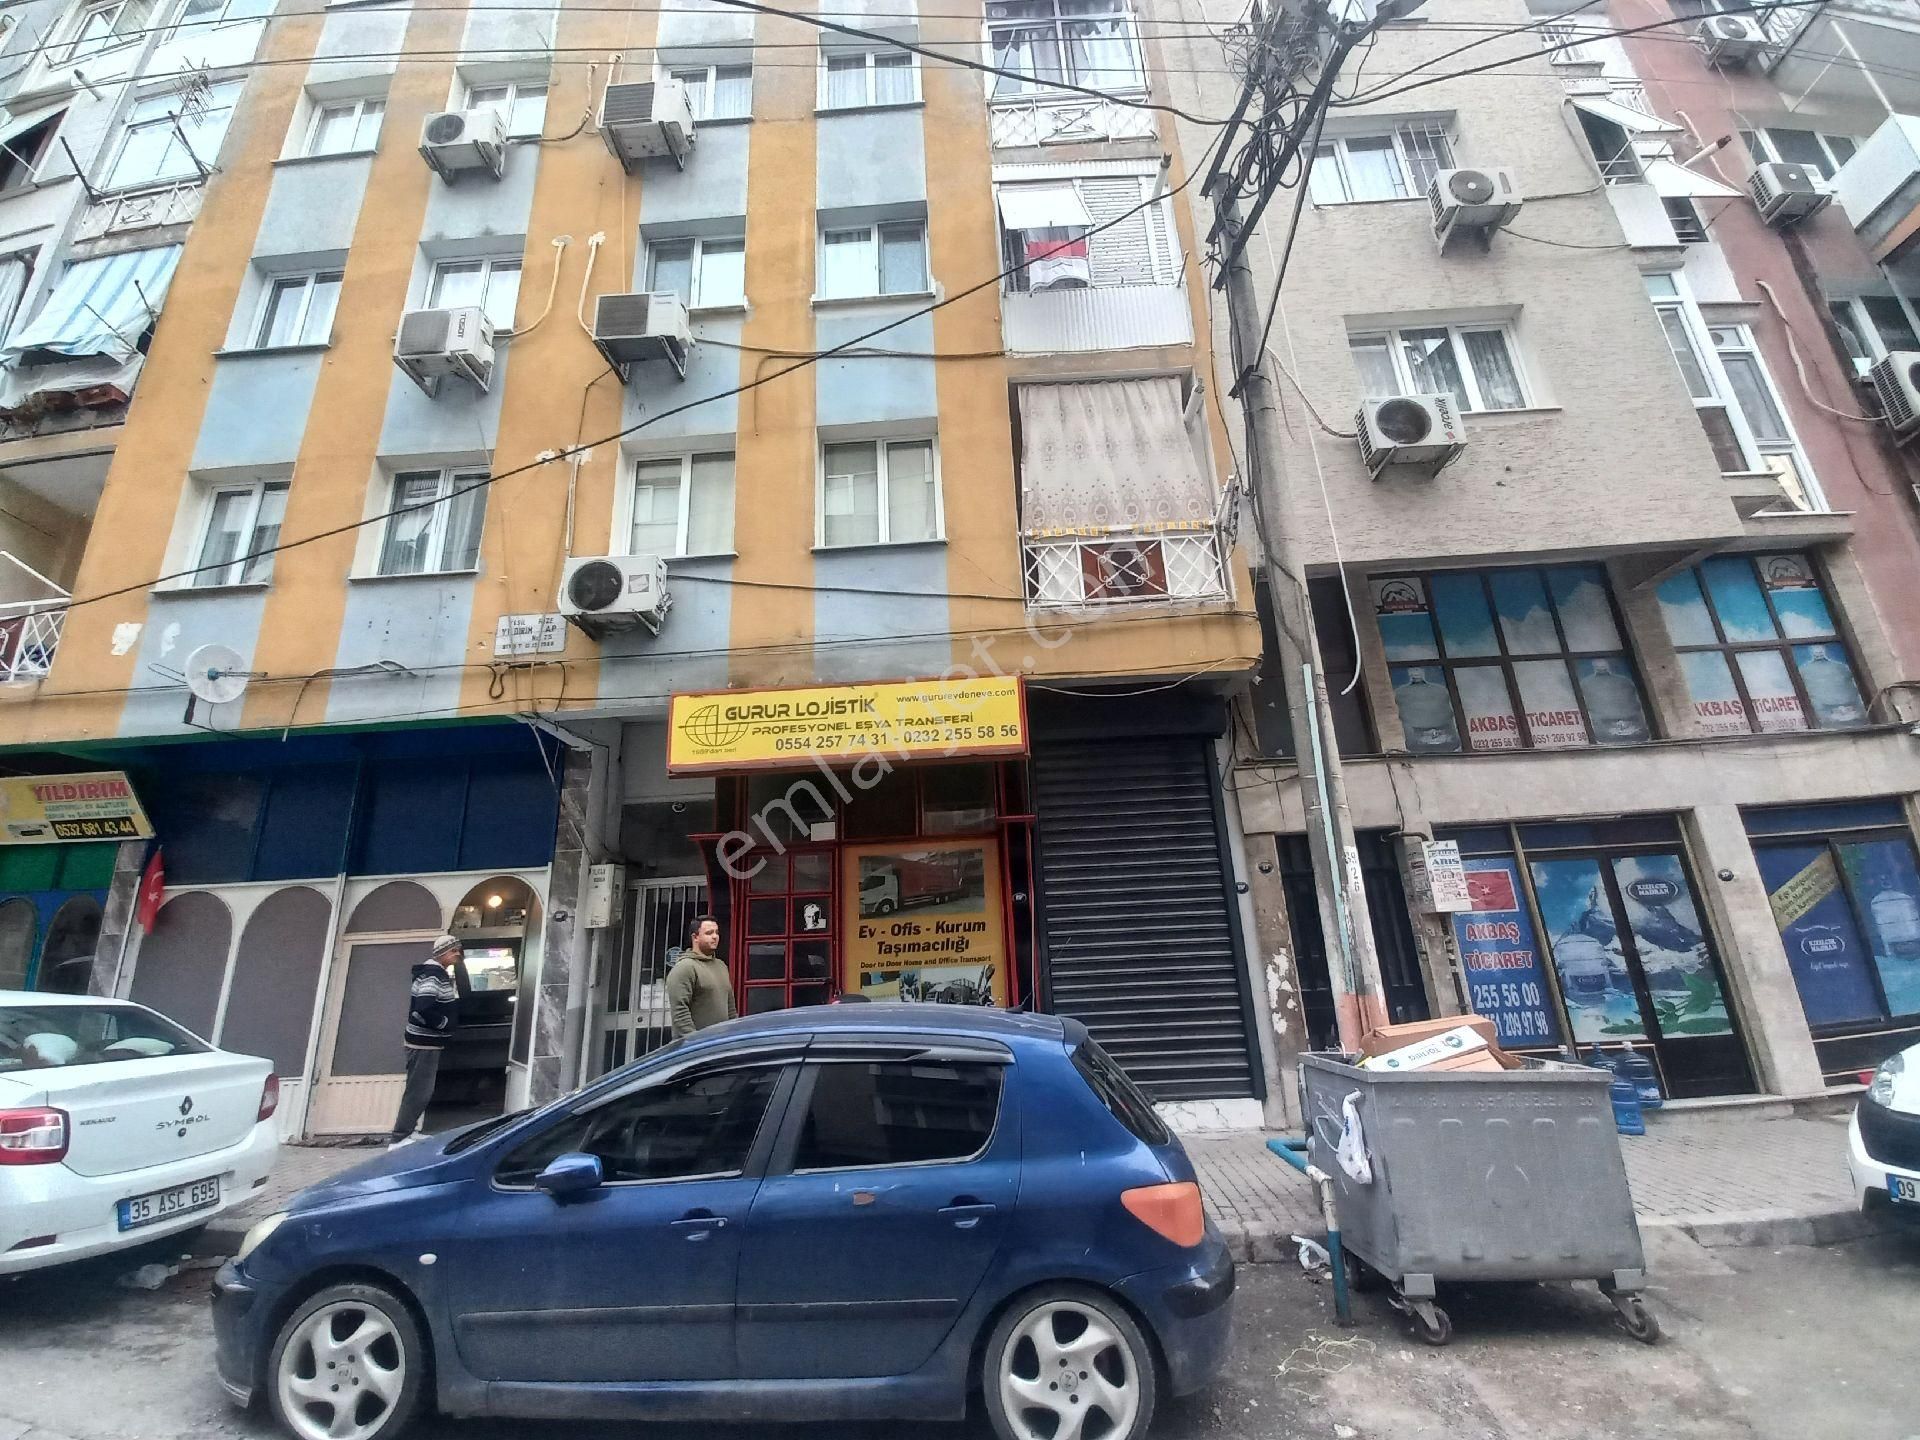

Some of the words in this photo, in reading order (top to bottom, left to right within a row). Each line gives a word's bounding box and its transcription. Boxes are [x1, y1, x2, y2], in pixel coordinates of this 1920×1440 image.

[896, 688, 1016, 703] www.gururevdeneve.com
[725, 703, 790, 721] GURUR
[796, 695, 876, 717] LOJİSTİK
[752, 721, 851, 736] PROFESYONEL
[856, 719, 892, 731] EŞYA
[896, 712, 974, 727] TRANSFERİ
[1470, 715, 1517, 734] AKBAŞ
[1526, 710, 1581, 728] TİCARET
[775, 738, 811, 751] 0554
[816, 735, 842, 749] 257
[849, 734, 866, 747] 74
[871, 733, 887, 746] 31
[904, 729, 940, 743] 0232
[945, 727, 972, 741] 255
[977, 726, 995, 739] 58
[1000, 724, 1019, 738] 56
[33, 779, 130, 802] YILDIRIM
[55, 824, 82, 837] 0532
[82, 821, 103, 835] 681
[104, 821, 119, 835] 43
[120, 820, 136, 833] 44
[858, 925, 877, 939] Ev
[890, 922, 921, 937] Ofis
[935, 920, 986, 935] Kurum
[1466, 922, 1520, 944] AKBAŞ
[877, 935, 970, 957] Taşımacılığı
[861, 961, 876, 969] Door
[960, 955, 991, 964] Transport
[1465, 949, 1533, 971] TİCARET
[1474, 984, 1500, 1009] 255
[1501, 982, 1520, 1007] 56
[1521, 981, 1540, 1007] 00
[1503, 1011, 1522, 1037] 209
[1523, 1010, 1536, 1036] 97
[1534, 1010, 1549, 1036] 98
[155, 1114, 211, 1130] SYMBOL
[131, 1199, 150, 1220] 35
[158, 1190, 185, 1214] ASC
[191, 1181, 216, 1204] 695
[1897, 1180, 1916, 1199] 09
